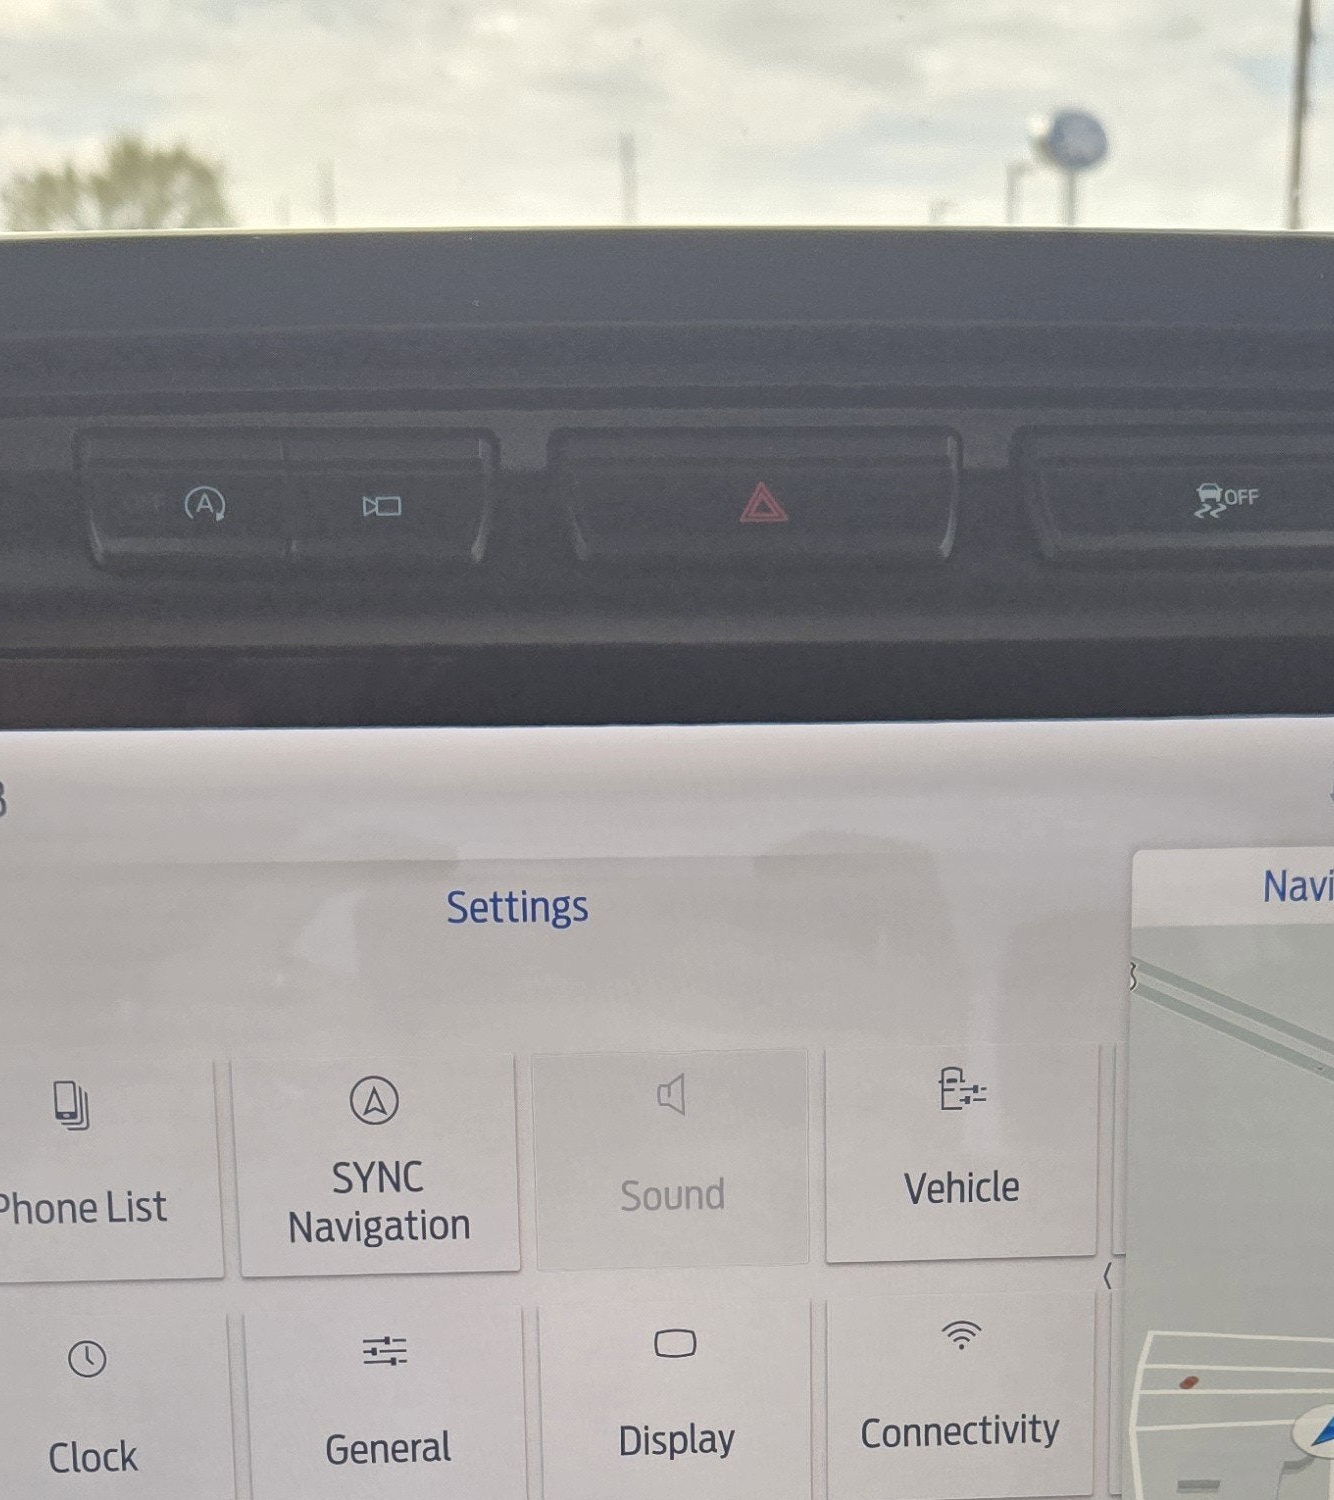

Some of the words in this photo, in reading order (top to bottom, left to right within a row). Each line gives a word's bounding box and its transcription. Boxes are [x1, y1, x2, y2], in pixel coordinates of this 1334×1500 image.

[1224, 488, 1260, 505] OFF
[447, 889, 589, 930] Settings
[332, 1160, 424, 1194] SYNC
[621, 1176, 725, 1212] Sound
[904, 1168, 1020, 1205] Vehicle
[106, 1188, 168, 1223] List
[289, 1208, 470, 1248] Navigation
[326, 1429, 452, 1466] General
[620, 1422, 736, 1461] Display
[861, 1413, 1060, 1450] Connectivity
[49, 1439, 139, 1474] Clock
